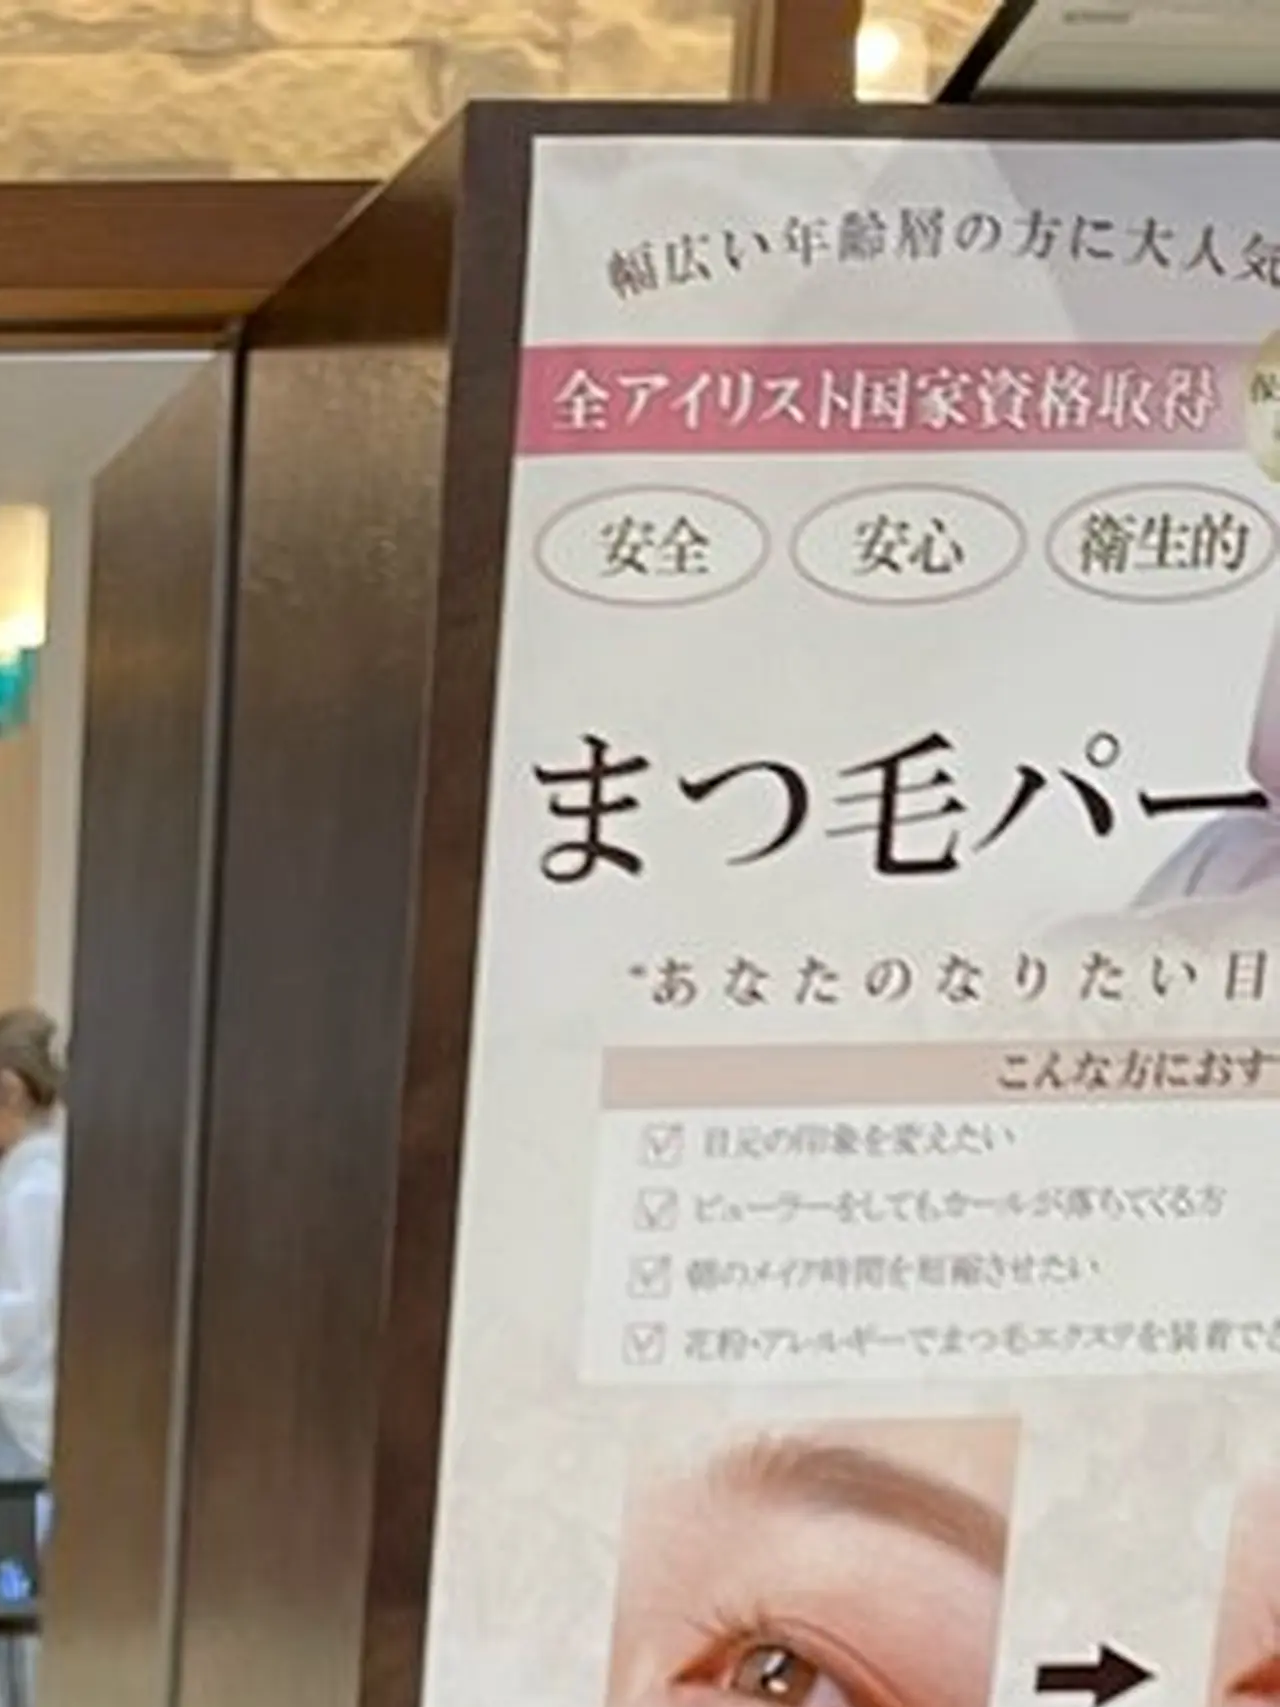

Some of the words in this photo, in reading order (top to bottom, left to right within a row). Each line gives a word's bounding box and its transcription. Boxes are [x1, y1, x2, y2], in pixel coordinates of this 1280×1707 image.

[551, 365, 1218, 433] 全アイリスト国家資格取得
[600, 515, 712, 577] 安全
[854, 515, 966, 577] 安心
[1078, 511, 1250, 575] 衛生的
[533, 730, 1270, 883] まつ毛パー
